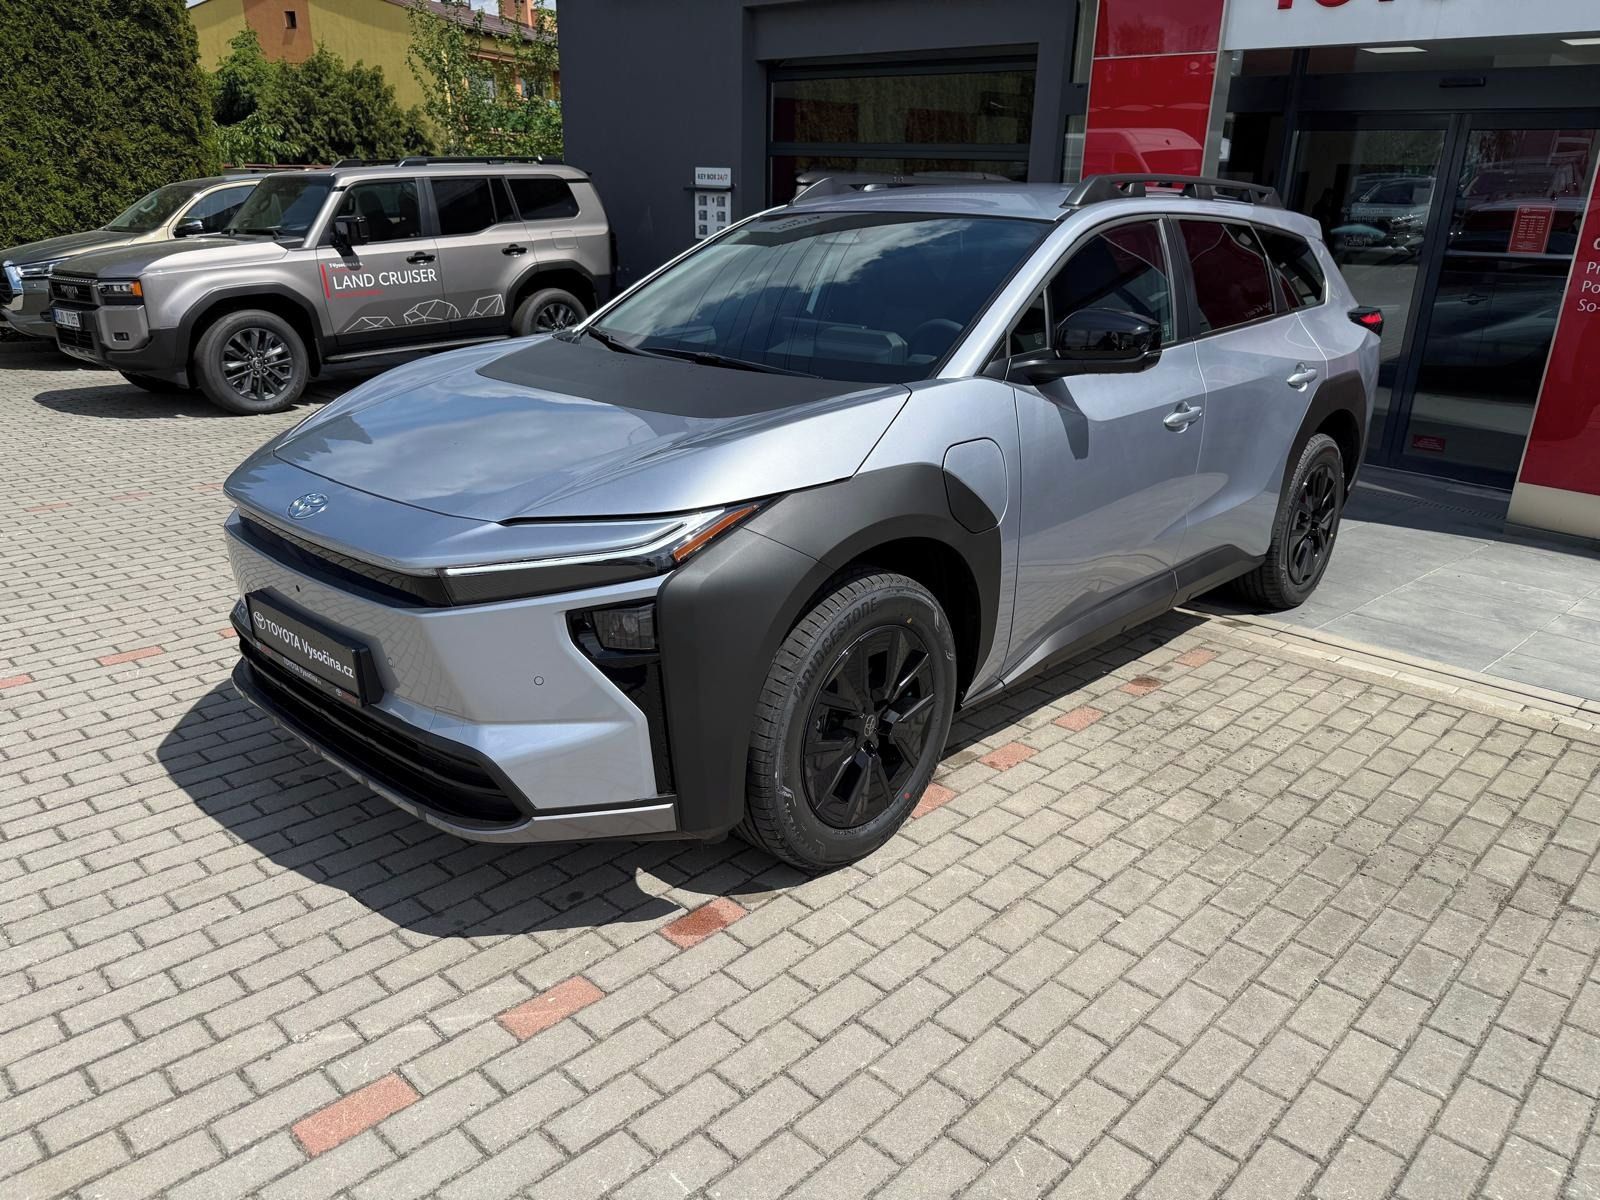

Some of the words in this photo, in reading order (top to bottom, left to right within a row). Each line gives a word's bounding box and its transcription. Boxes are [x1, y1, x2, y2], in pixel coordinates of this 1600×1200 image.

[333, 273, 375, 290] LAND
[379, 268, 438, 286] CRUISER
[265, 619, 301, 651] TOYOTA
[302, 638, 354, 679] Vysočina.cz
[793, 597, 878, 699] BRIDGESTONE
